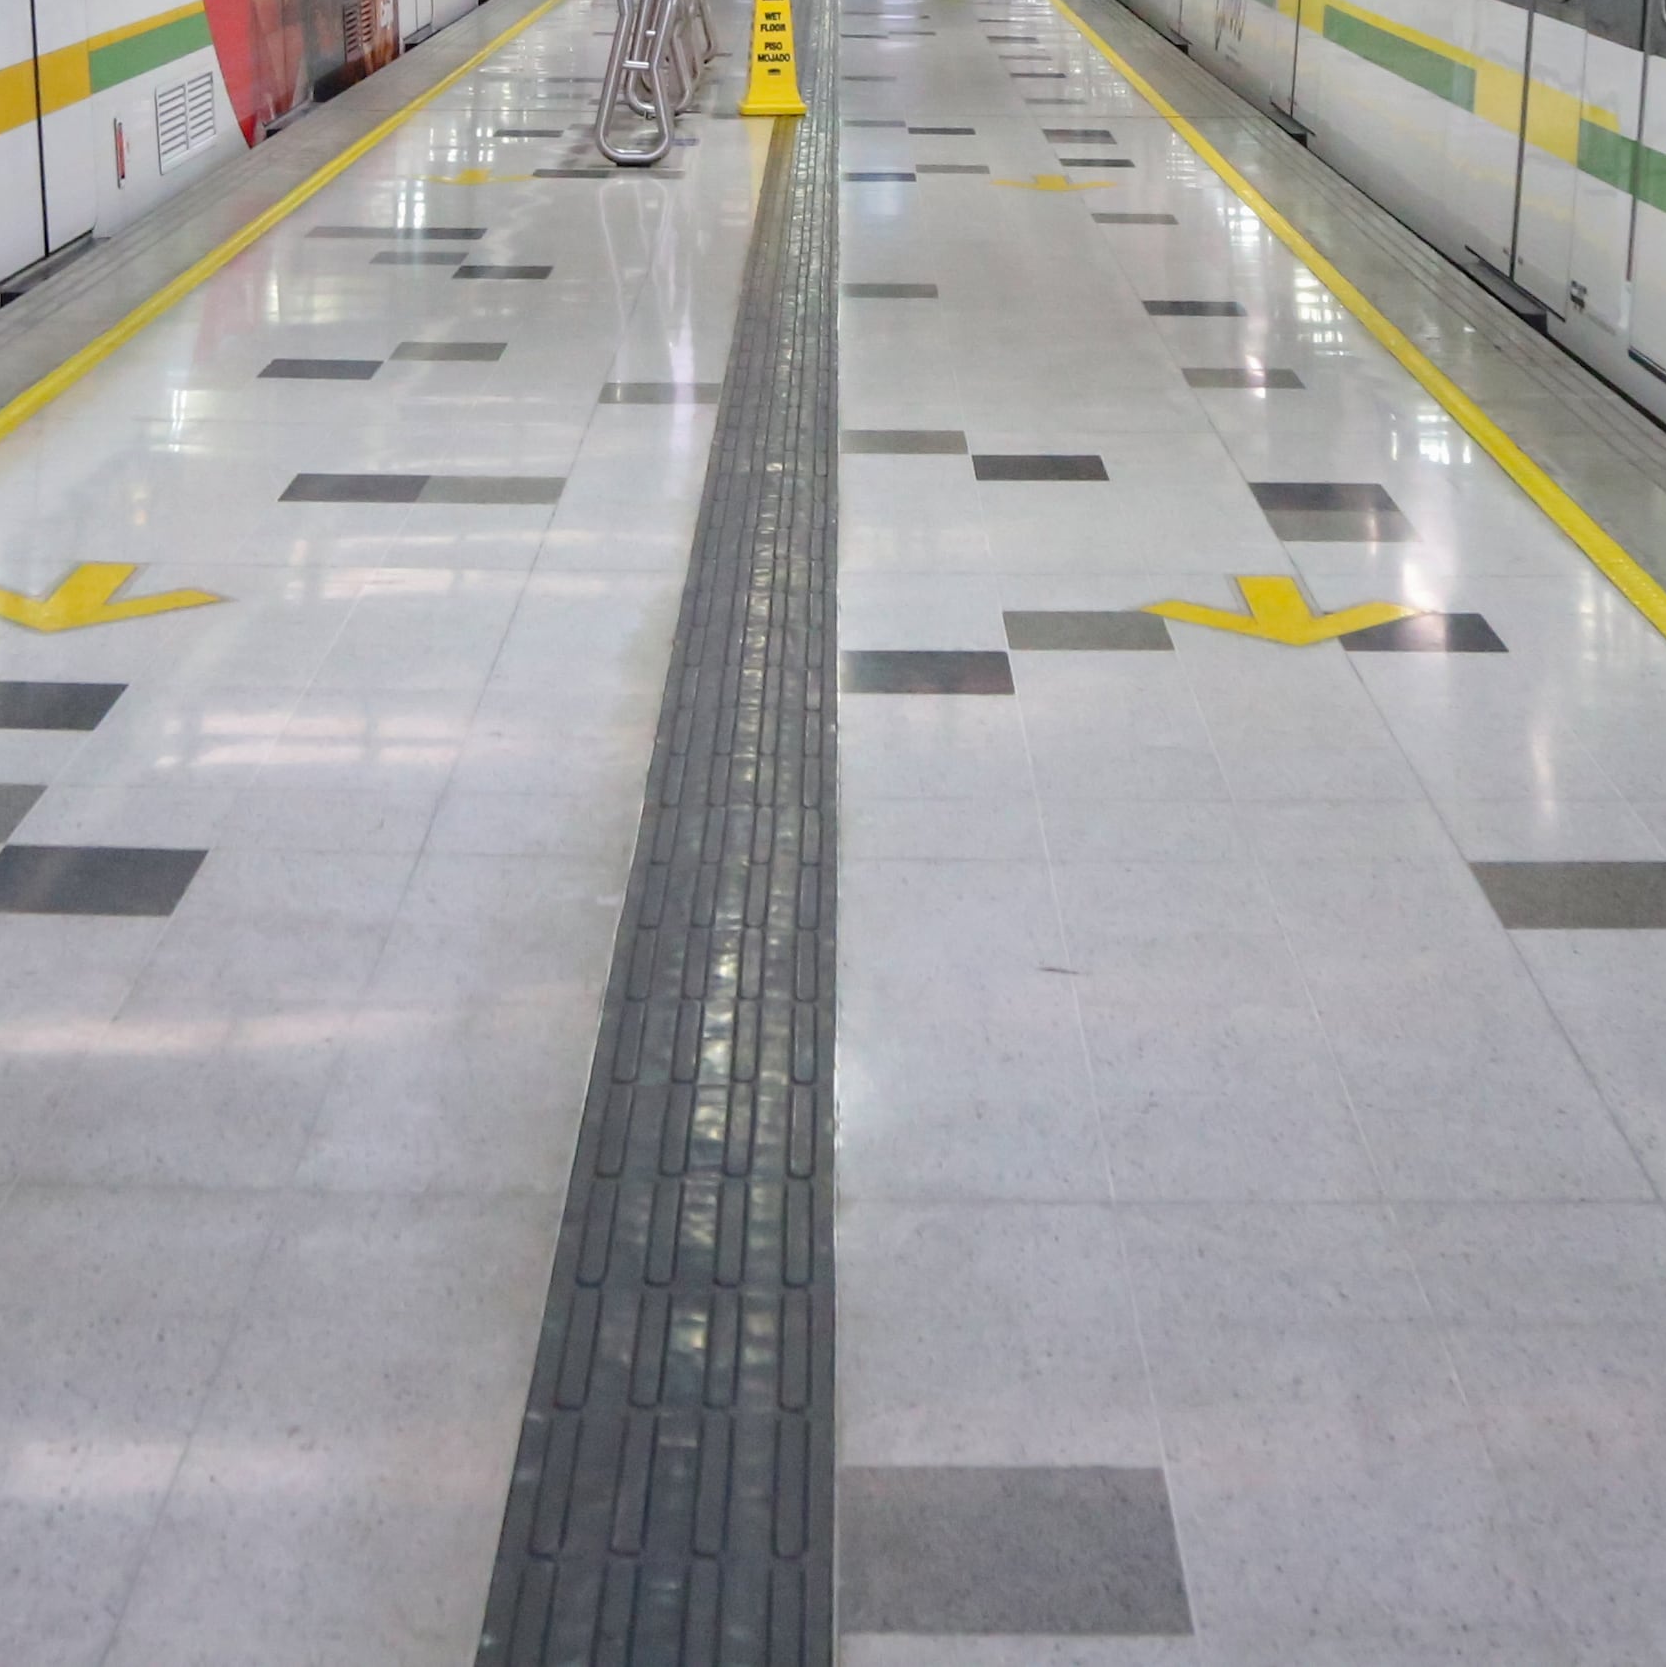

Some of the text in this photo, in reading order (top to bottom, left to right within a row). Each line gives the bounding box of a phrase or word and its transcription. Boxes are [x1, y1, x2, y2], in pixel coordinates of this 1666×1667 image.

[765, 12, 781, 21] WET
[760, 23, 787, 33] FLOOR
[764, 41, 783, 51] PISO
[757, 53, 791, 63] MOJADO
